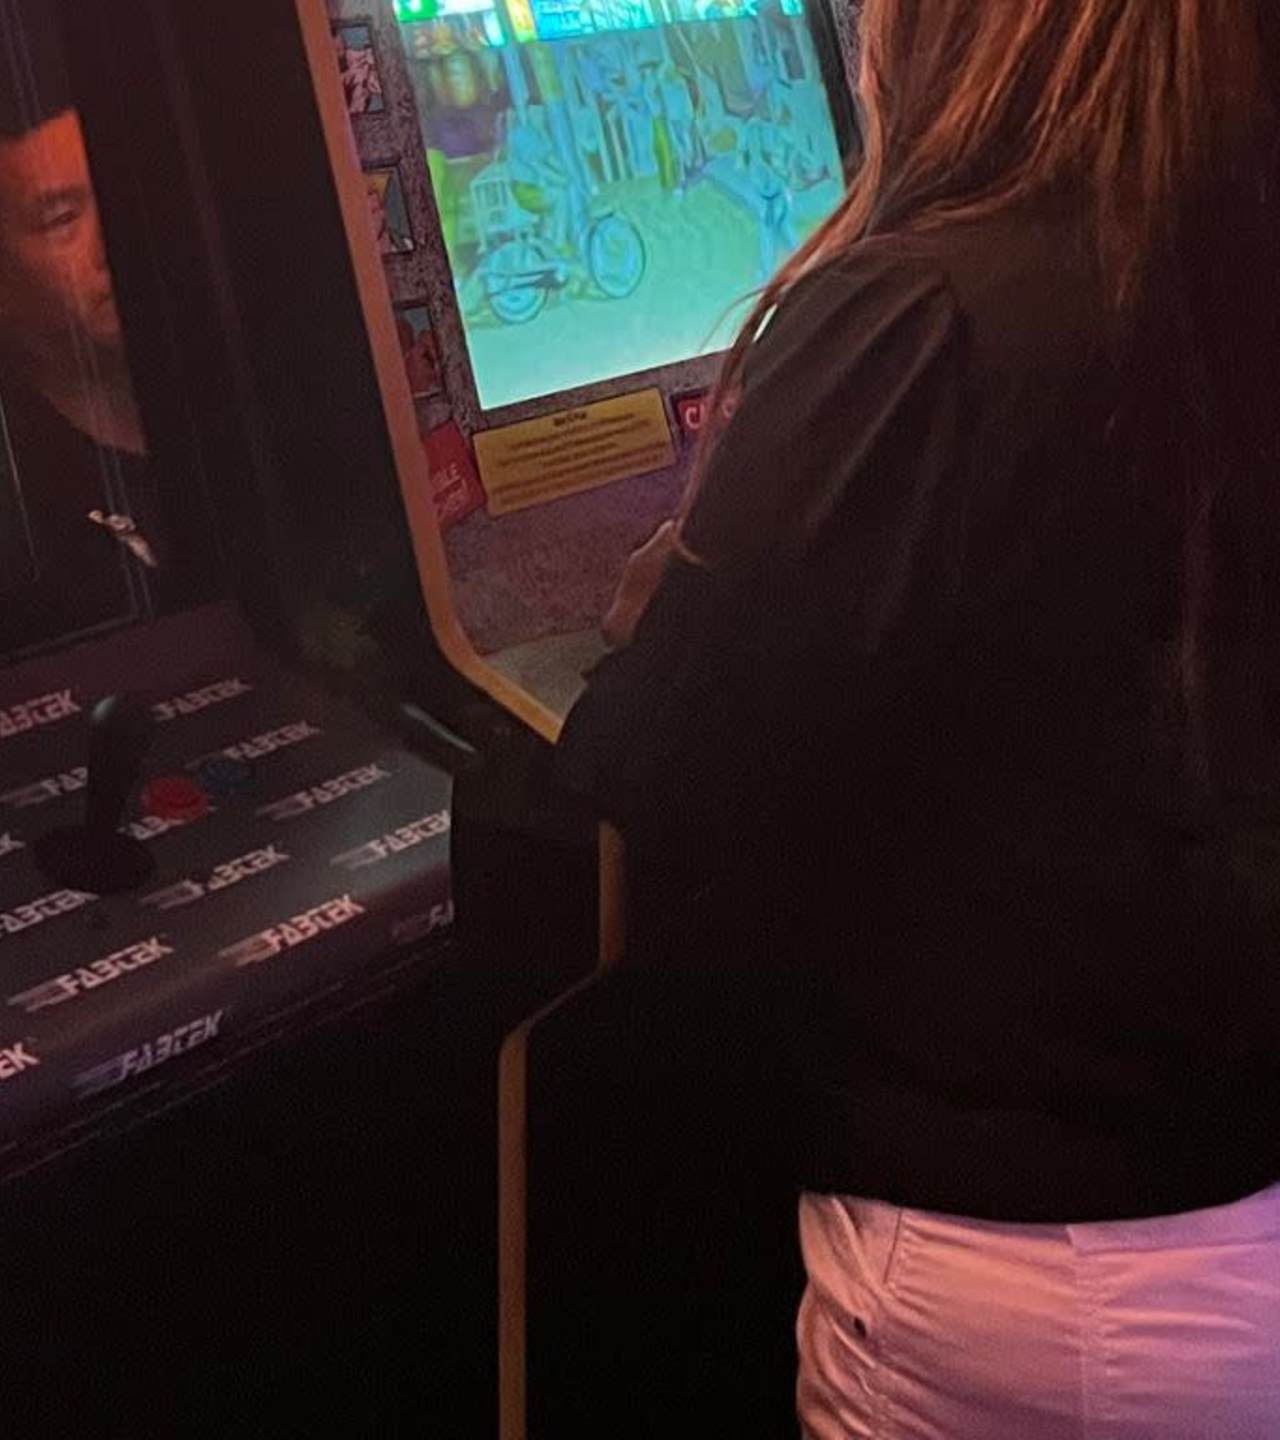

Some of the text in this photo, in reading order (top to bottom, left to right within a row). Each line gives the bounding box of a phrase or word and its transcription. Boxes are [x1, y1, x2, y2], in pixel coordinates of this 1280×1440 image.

[297, 761, 392, 807] FABTEK
[264, 892, 367, 951] FABTEK
[58, 935, 176, 997] FABTEK
[118, 1010, 225, 1080] FABTEK
